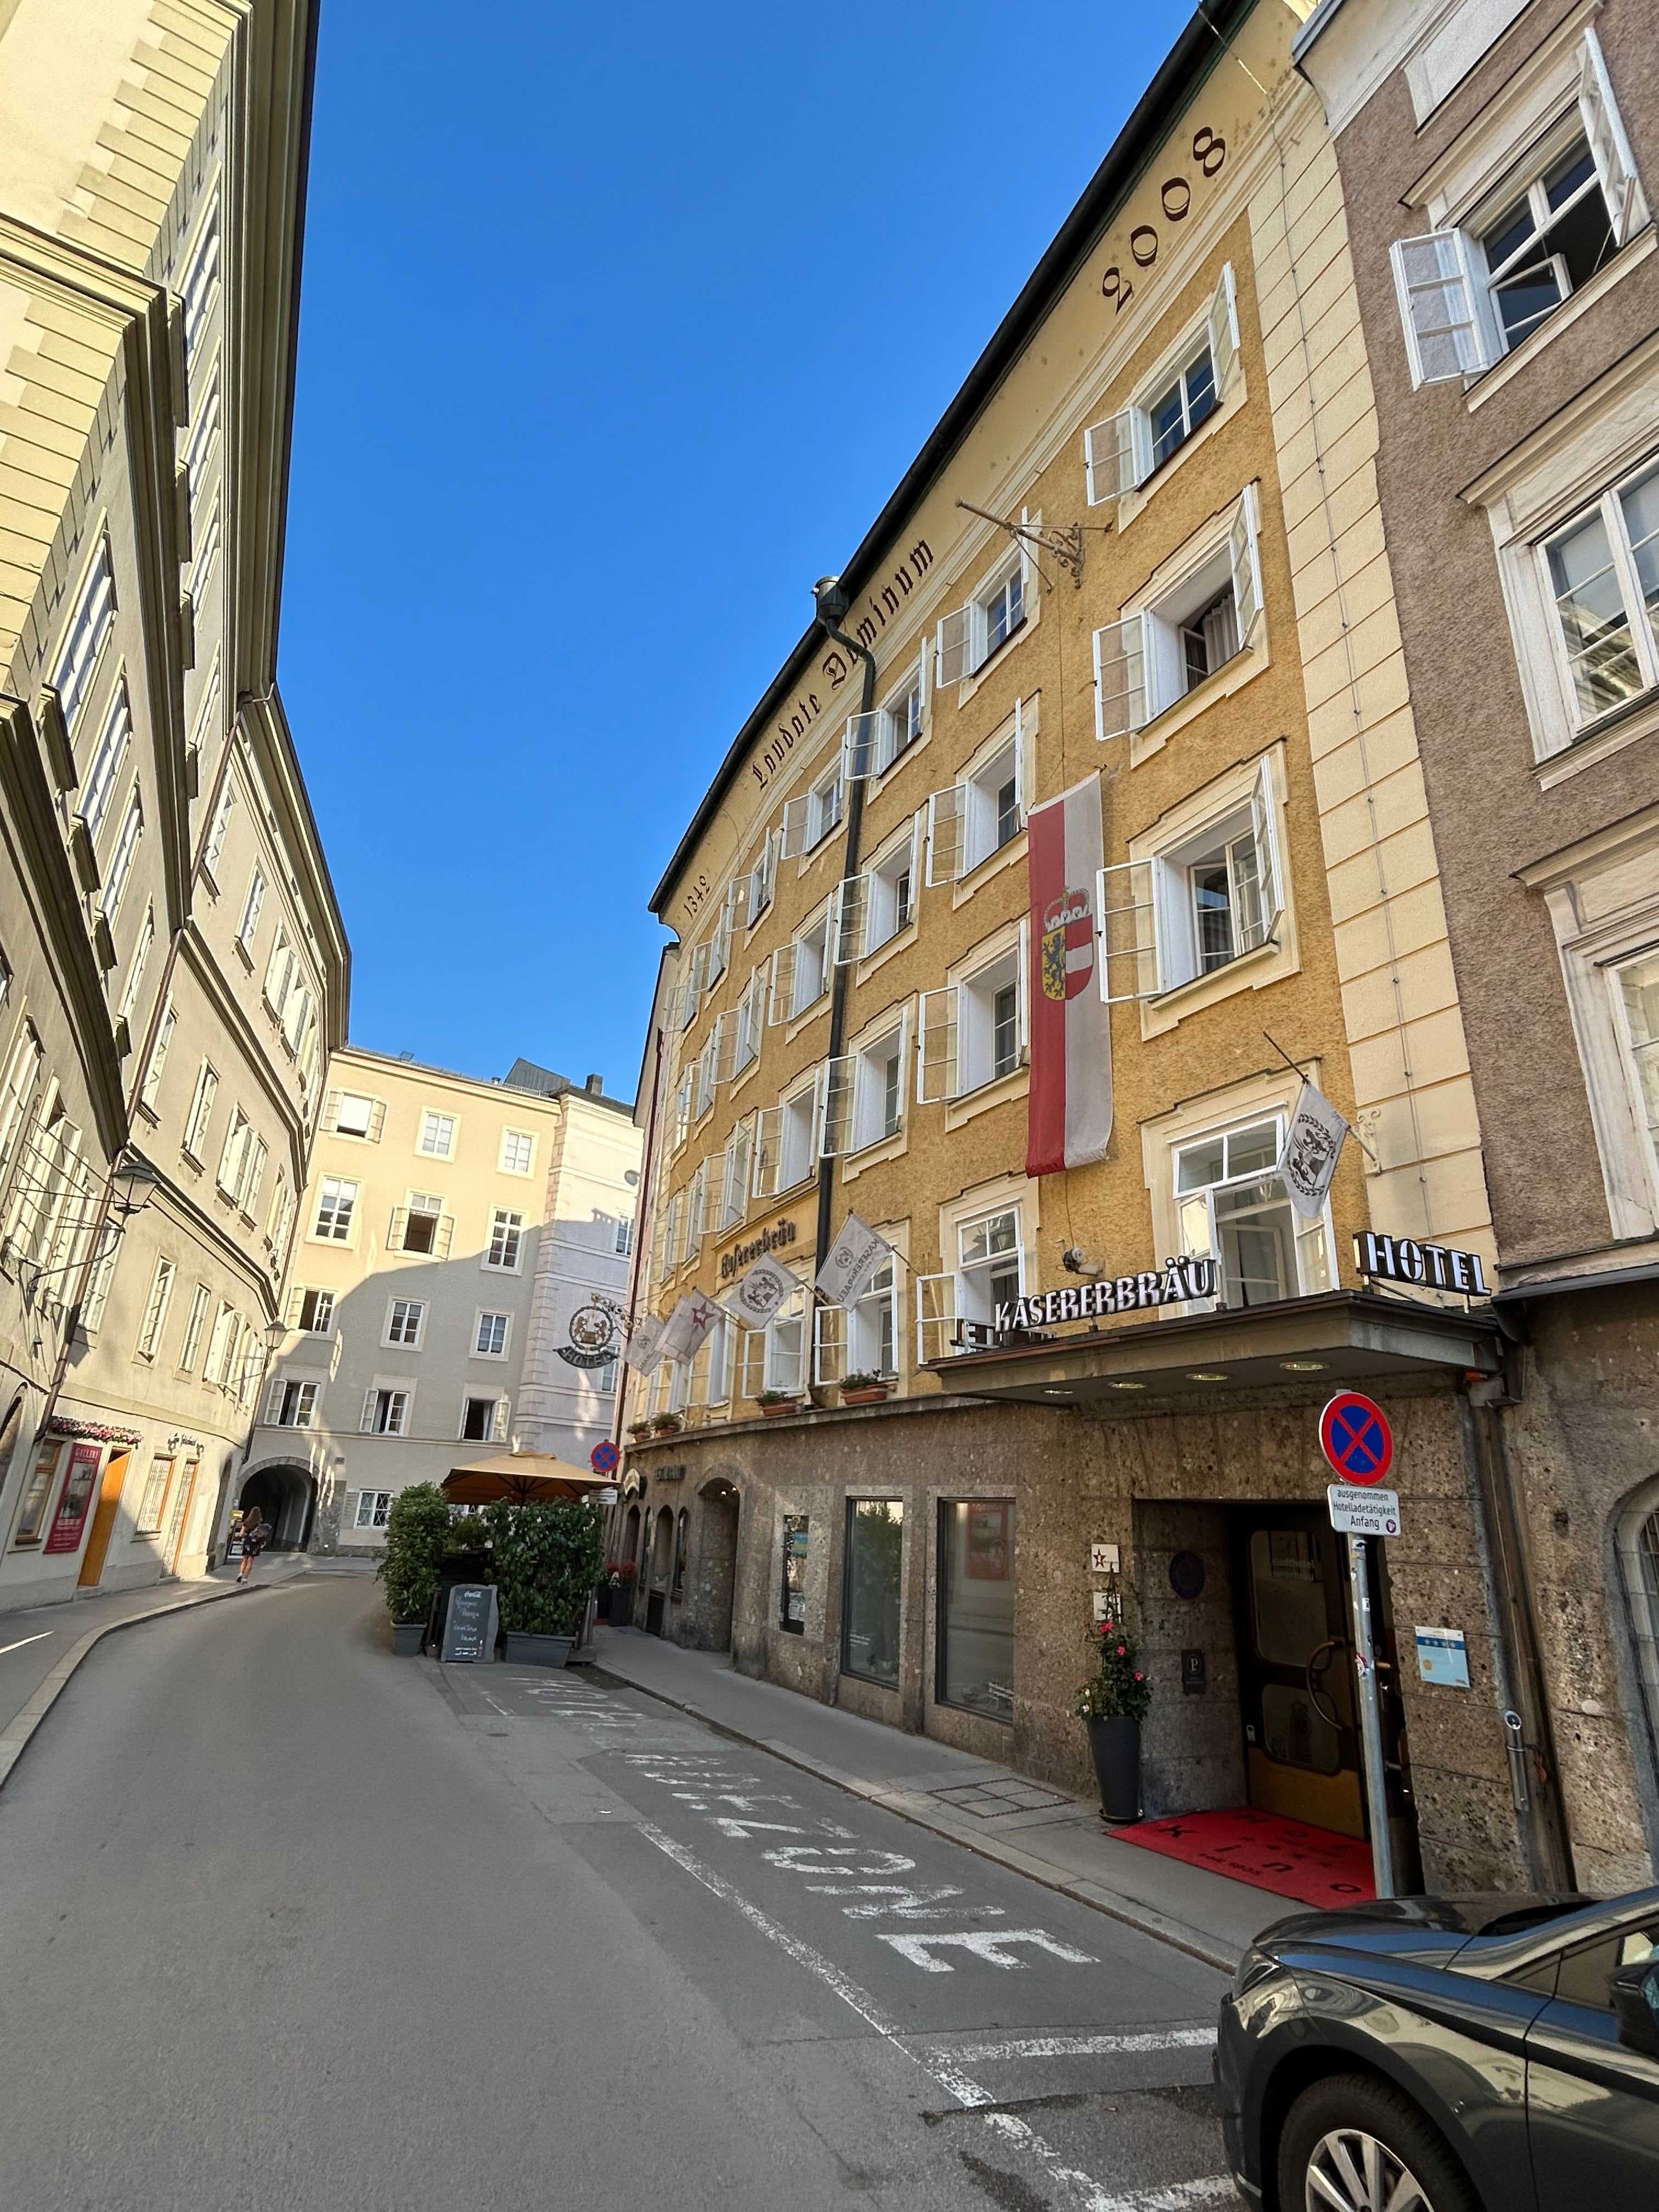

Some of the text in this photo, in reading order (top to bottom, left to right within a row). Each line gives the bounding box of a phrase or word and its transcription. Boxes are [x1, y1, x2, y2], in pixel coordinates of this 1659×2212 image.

[1102, 127, 1226, 315] 2008
[684, 876, 710, 920] 1342
[1362, 1231, 1492, 1296] HOTEL
[994, 1255, 1218, 1333] KASERERBRÄU
[563, 1348, 611, 1366] HOTEL
[1333, 1501, 1397, 1516] Hotelladetätigkeit
[1337, 1489, 1389, 1502] ausgenommen
[1351, 1515, 1380, 1530] Anfang
